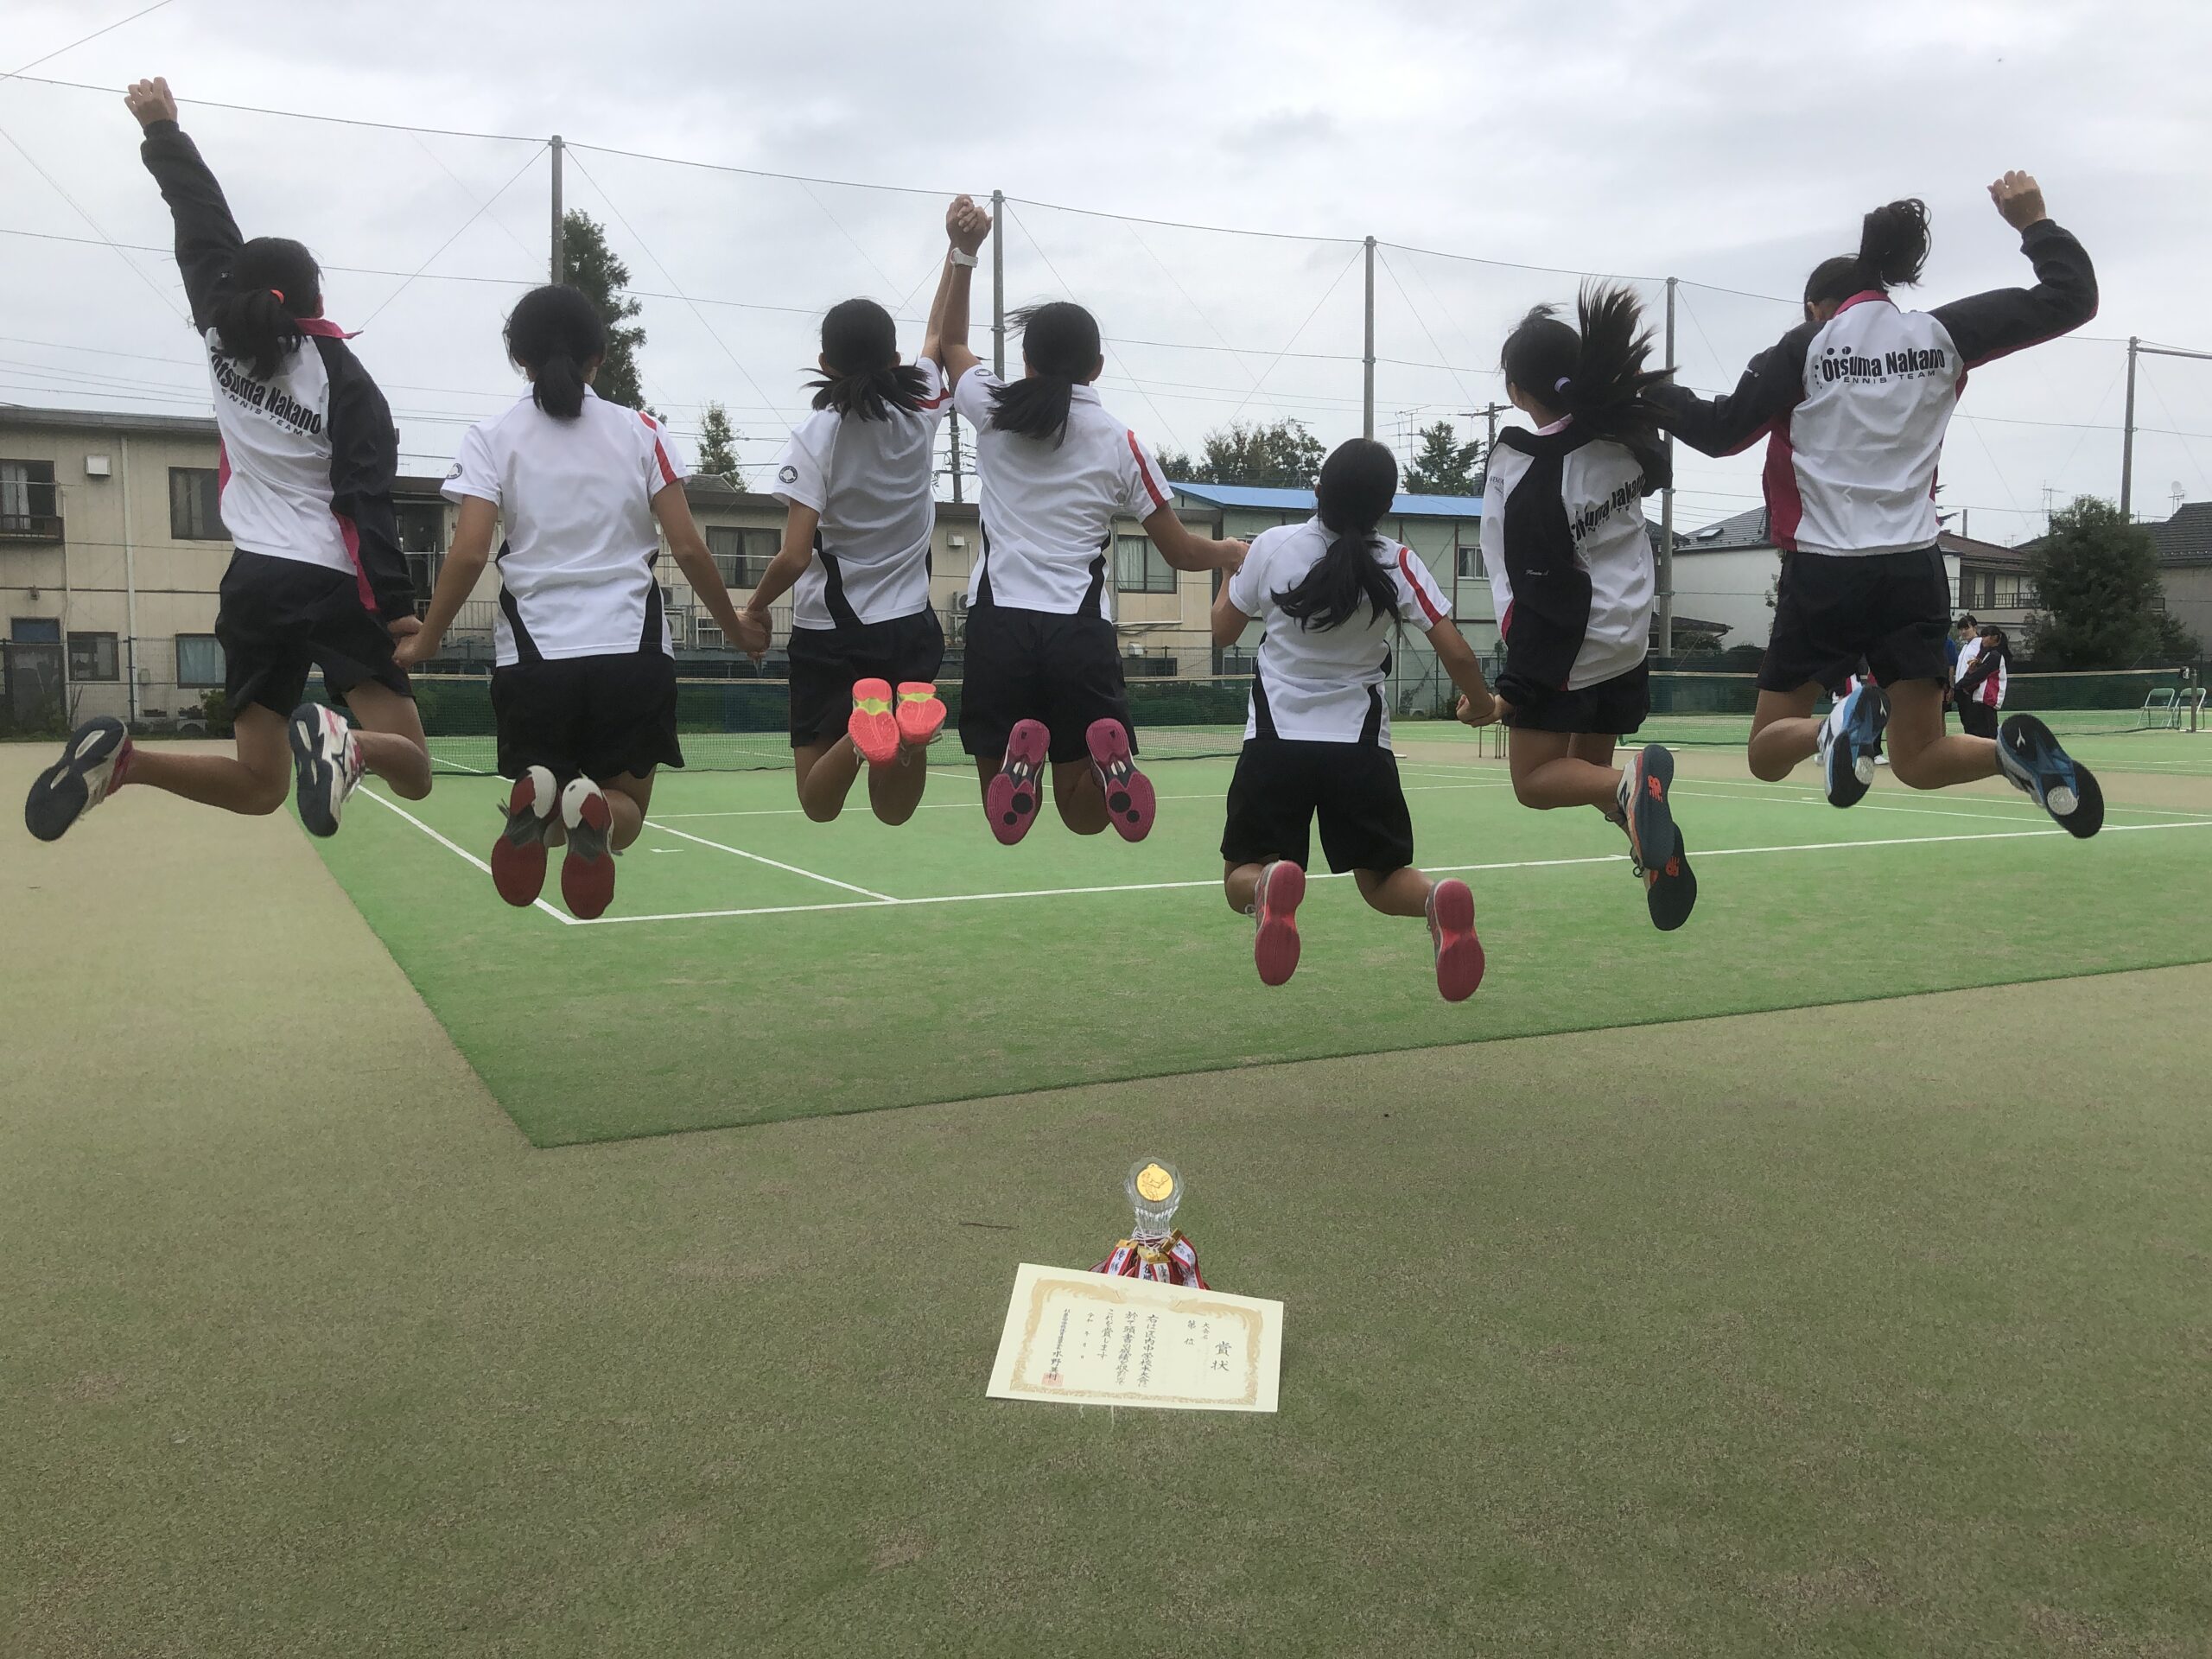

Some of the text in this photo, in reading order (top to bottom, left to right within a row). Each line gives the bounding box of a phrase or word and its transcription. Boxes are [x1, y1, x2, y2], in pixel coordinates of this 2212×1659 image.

[1822, 347, 1946, 383] Otsuma Nakano
[1838, 370, 1936, 385] ENNIS TEAM
[264, 386, 321, 435] Nakano
[269, 415, 303, 437] TEAM
[1096, 1308, 1114, 1360] これを賞します
[1210, 1340, 1232, 1372] 賞状
